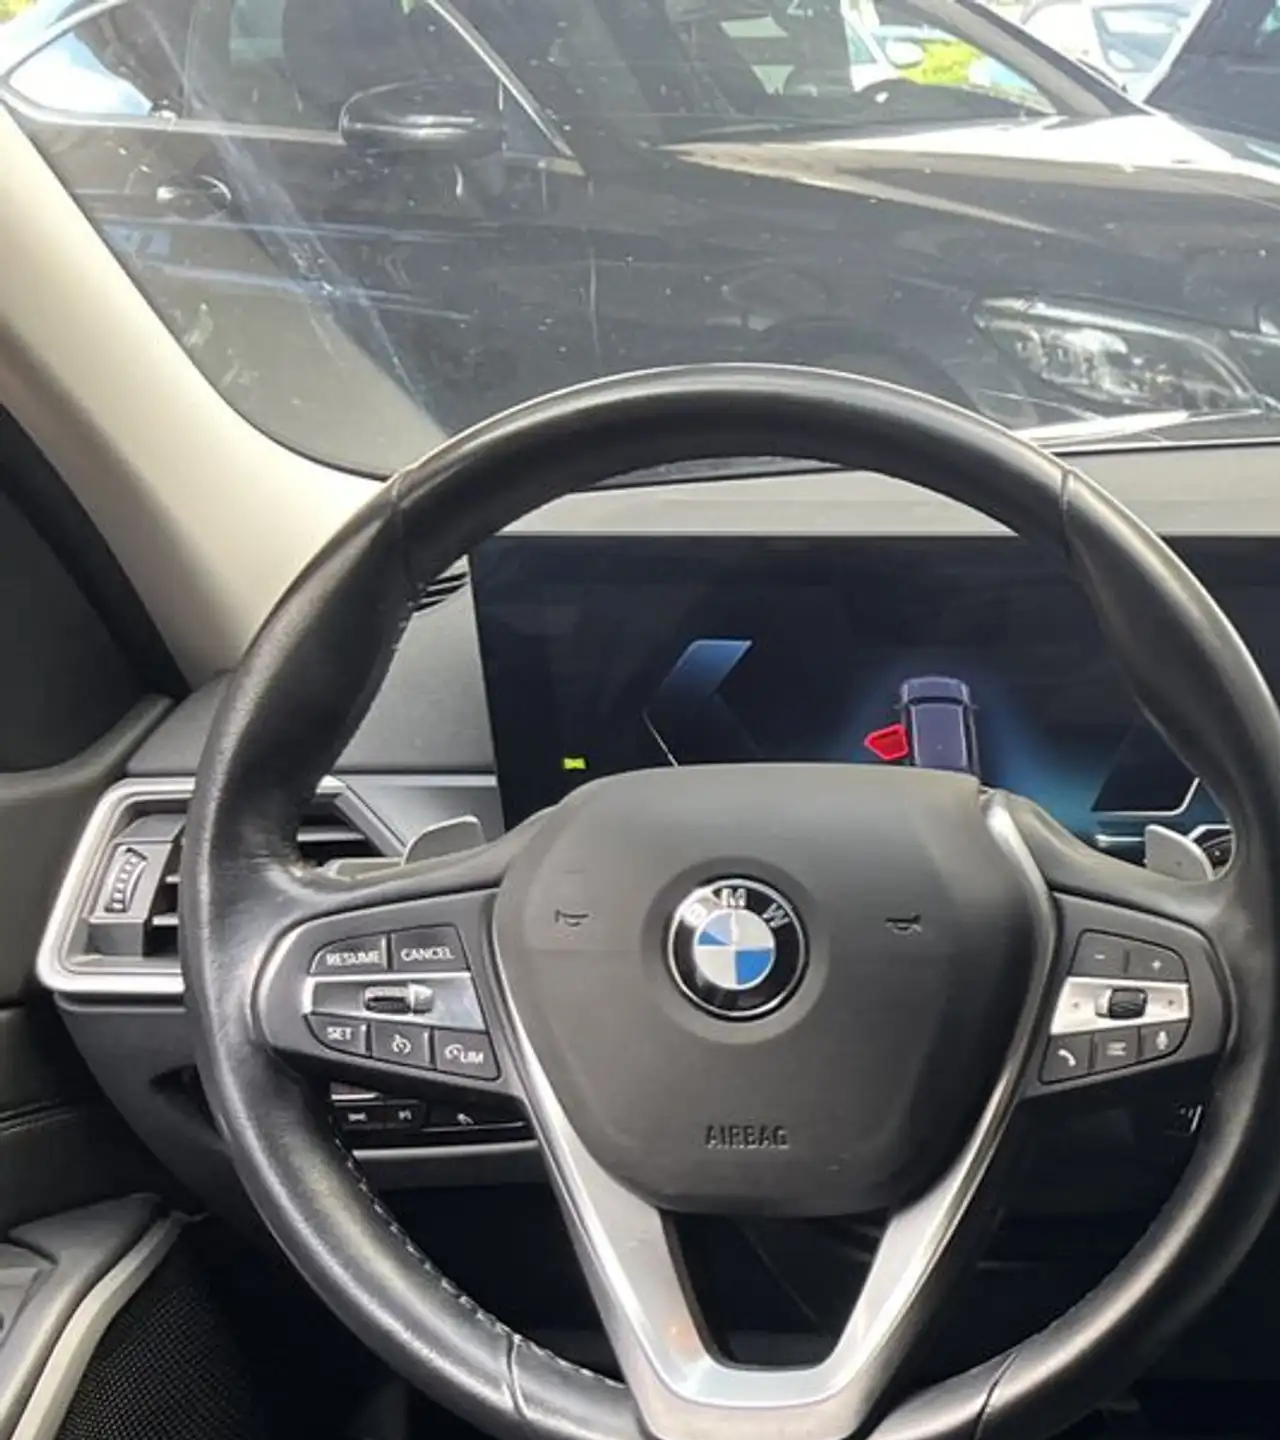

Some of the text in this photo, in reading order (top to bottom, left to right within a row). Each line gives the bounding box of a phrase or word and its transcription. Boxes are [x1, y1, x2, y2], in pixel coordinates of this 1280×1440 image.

[682, 886, 791, 930] BMW
[326, 951, 380, 966] RESUME
[401, 947, 454, 962] CANCEL
[327, 1026, 352, 1041] SET
[460, 1049, 485, 1065] LIM
[704, 1123, 790, 1150] AIRBAG
